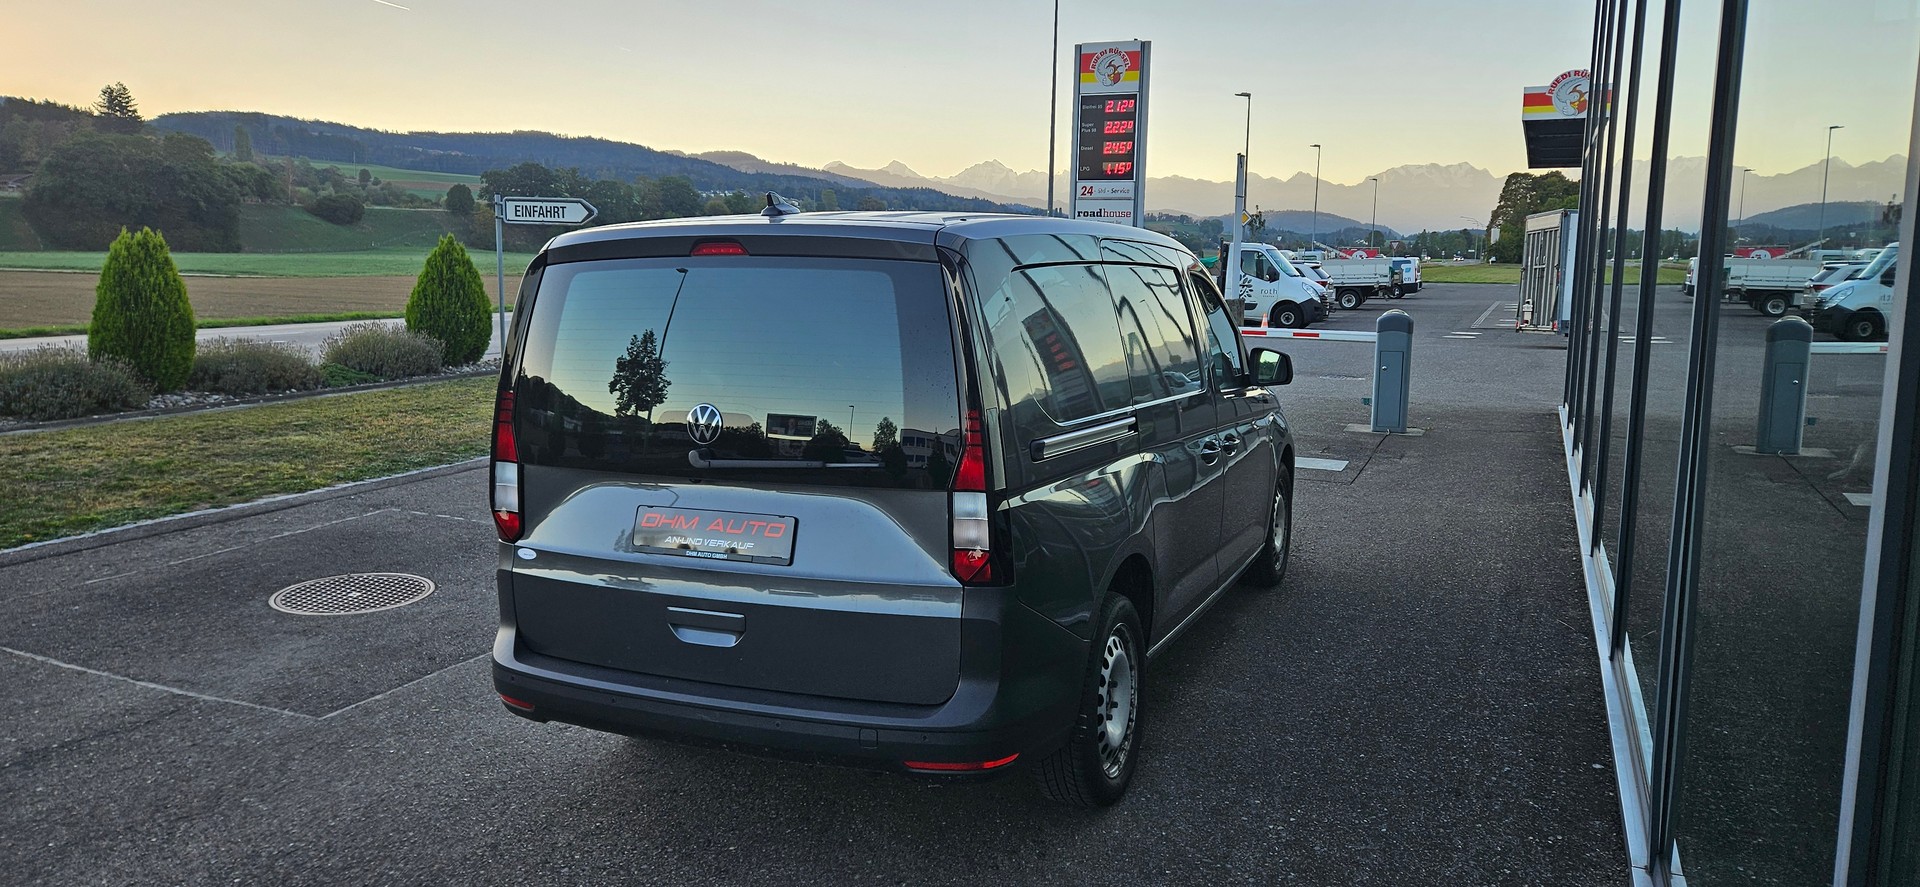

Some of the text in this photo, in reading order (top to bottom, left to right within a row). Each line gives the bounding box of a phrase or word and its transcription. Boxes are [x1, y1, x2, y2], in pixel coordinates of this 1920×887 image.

[1091, 46, 1130, 70] RUEDI RÜSSEL
[1548, 71, 1571, 95] RUEDI
[1080, 185, 1094, 196] 24
[514, 204, 567, 219] EINFAHRT
[1076, 207, 1132, 218] roadhouse
[641, 512, 787, 539] DHM AUTO
[703, 538, 755, 550] VERKAUF
[697, 551, 711, 559] AUTO
